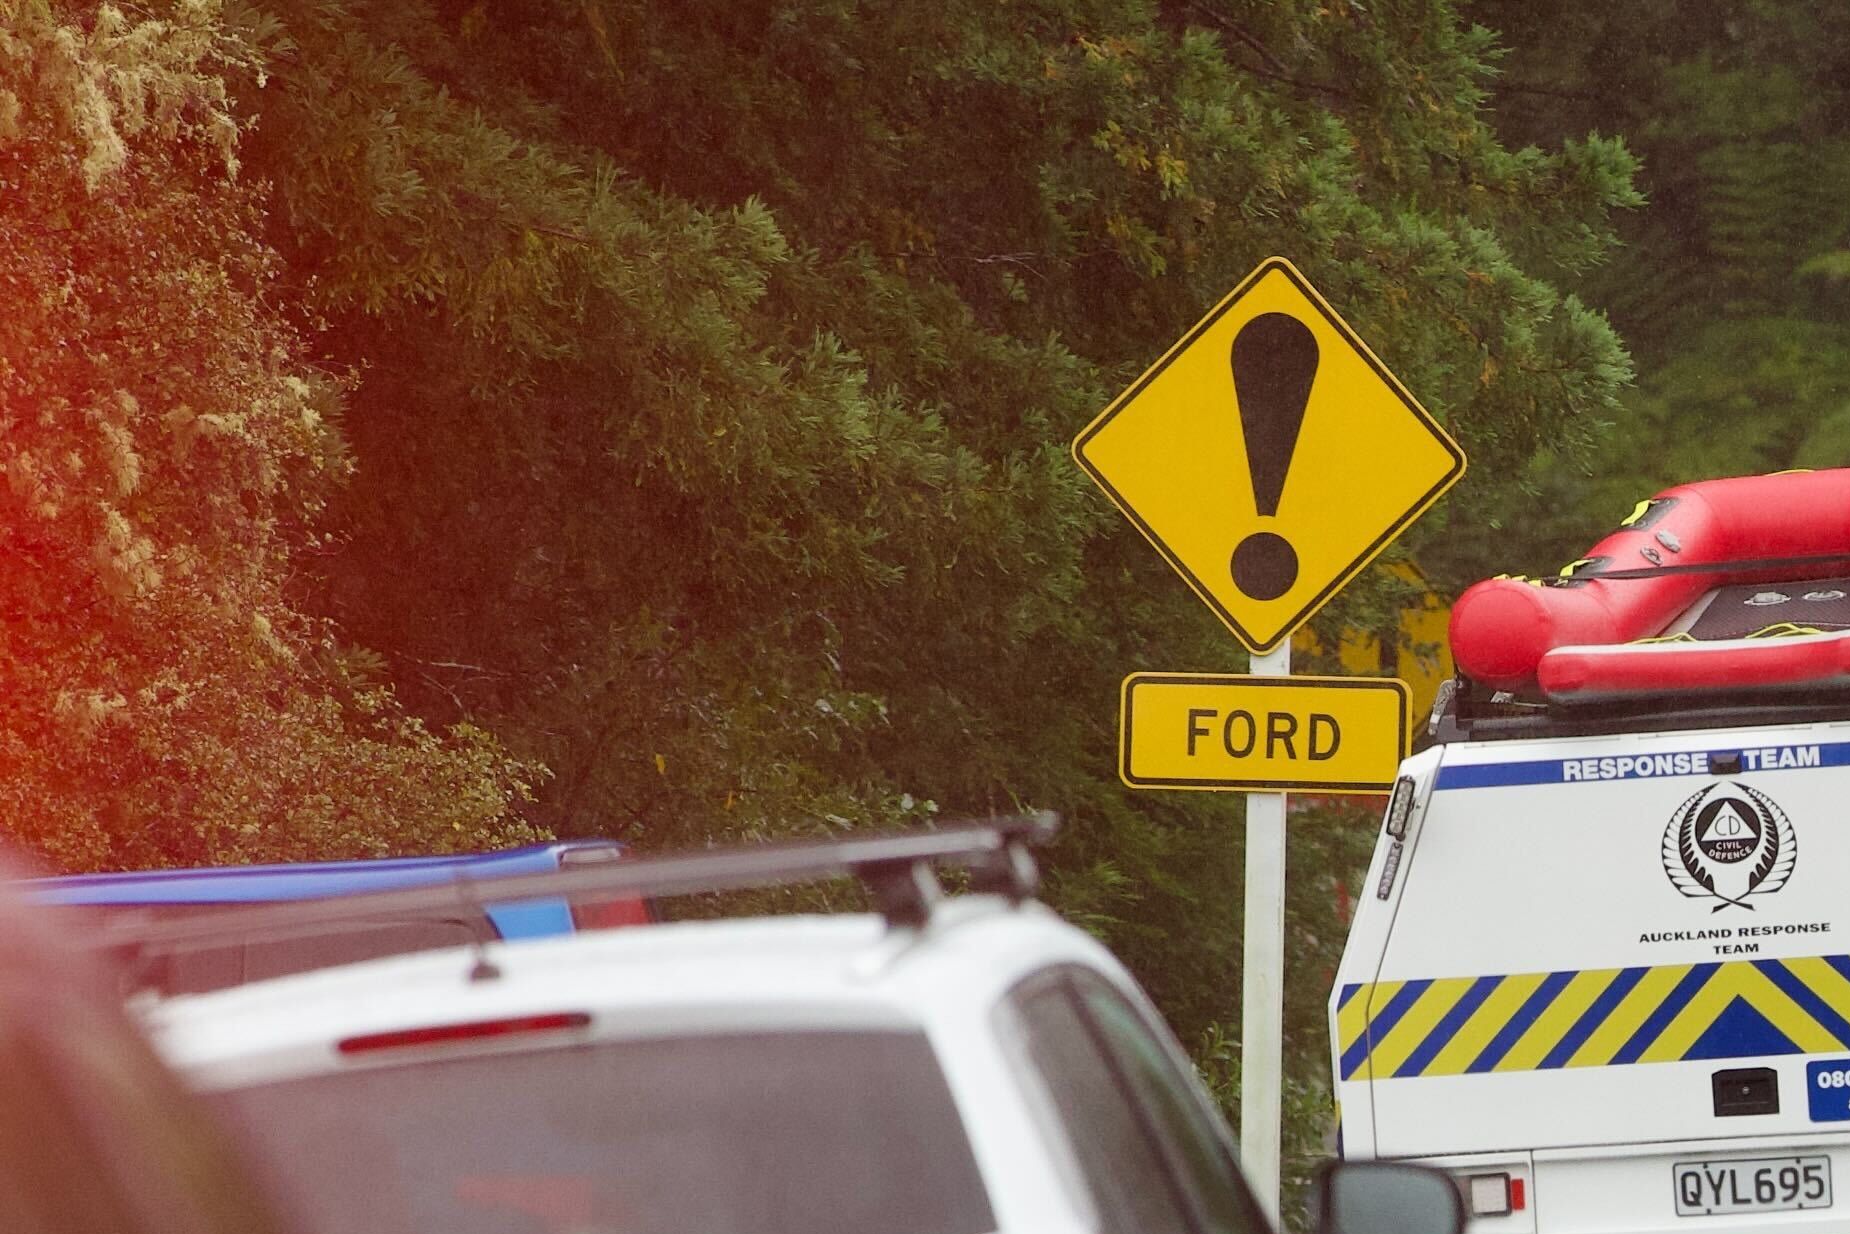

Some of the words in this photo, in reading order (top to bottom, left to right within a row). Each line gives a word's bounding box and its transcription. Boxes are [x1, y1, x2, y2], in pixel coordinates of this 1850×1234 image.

[1186, 708, 1342, 761] FORD
[1562, 753, 1709, 781] RESPONSE
[1743, 746, 1821, 770] TEAM
[1714, 815, 1741, 836] CD
[1708, 846, 1753, 860] DEFENCE
[1715, 841, 1742, 850] CIVIL
[1639, 928, 1733, 944] AUCKLAND
[1738, 922, 1832, 938] RESPONSE
[1713, 943, 1760, 955] TEAM
[1680, 1164, 1825, 1207] QYL695
